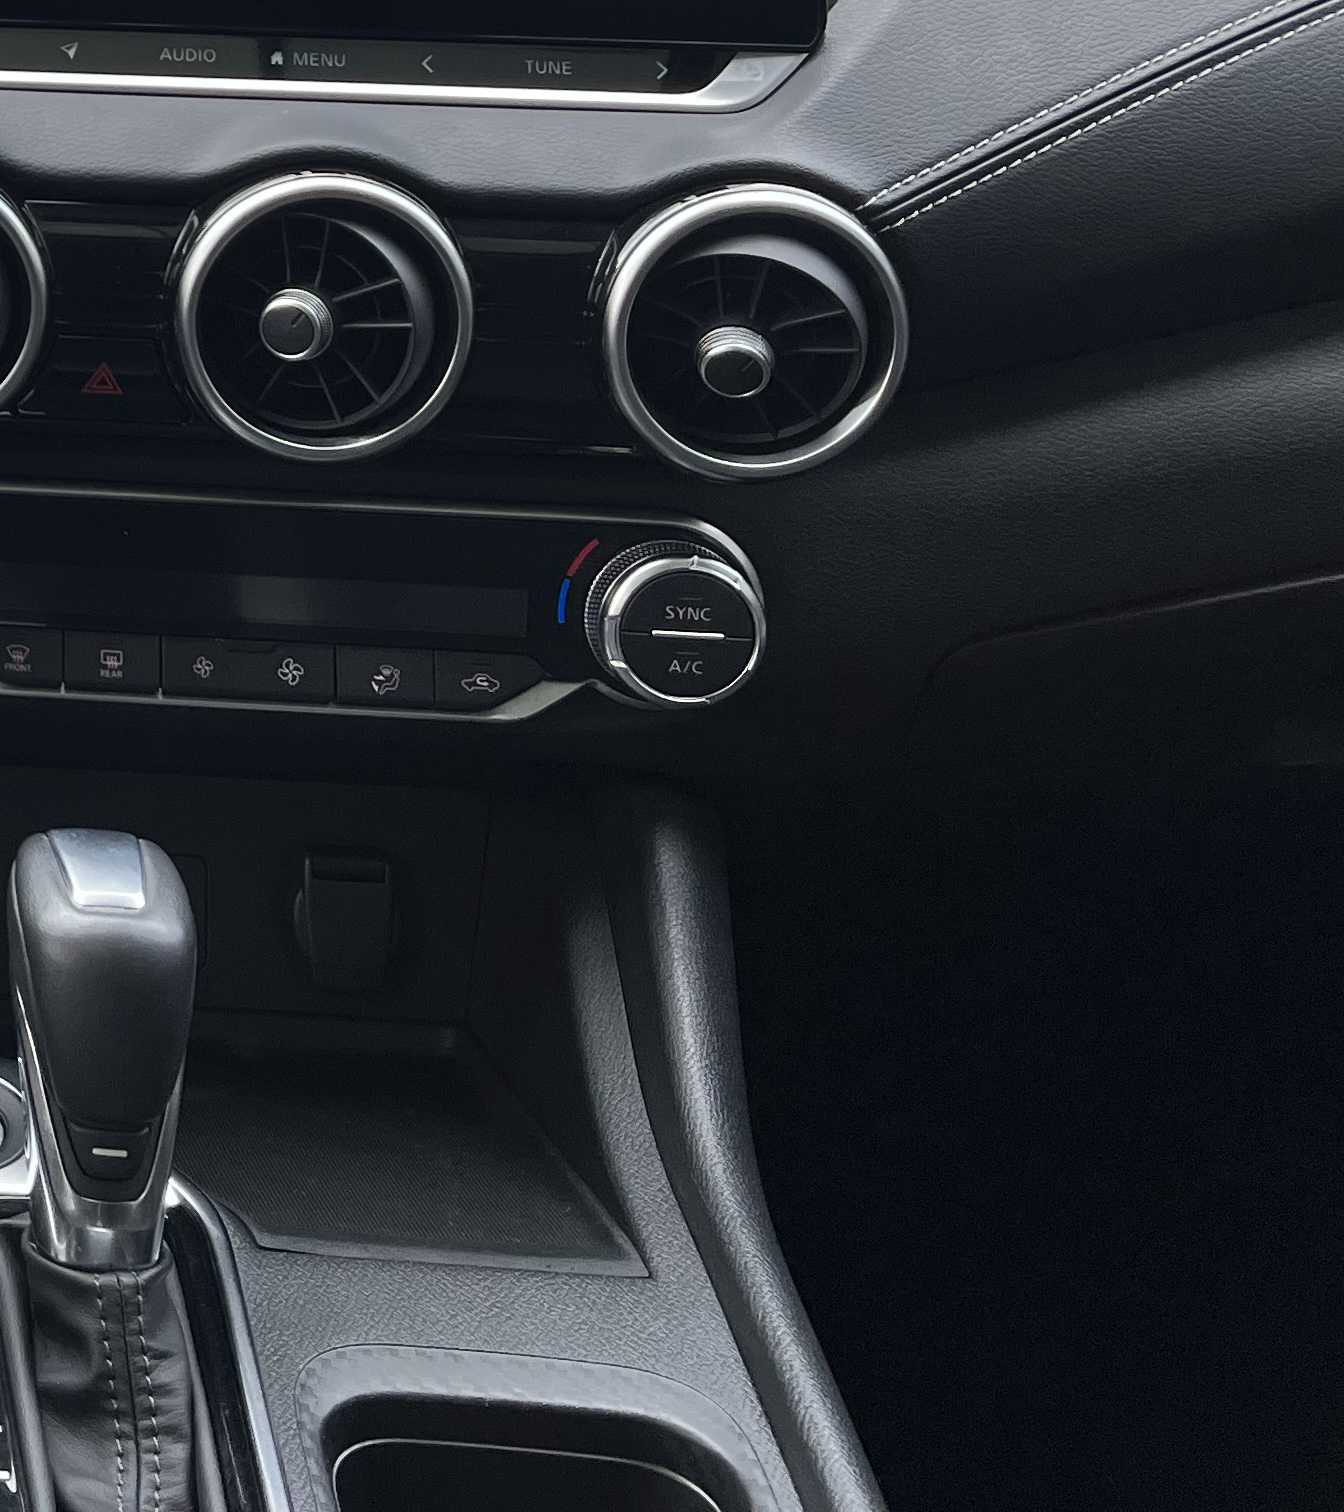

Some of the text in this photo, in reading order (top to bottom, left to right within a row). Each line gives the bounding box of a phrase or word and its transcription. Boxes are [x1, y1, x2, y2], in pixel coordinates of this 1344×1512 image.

[160, 47, 217, 63] AUDIO
[293, 52, 347, 68] MENU
[524, 59, 573, 76] TUNE
[664, 604, 713, 623] SYNC
[4, 663, 32, 673] FRONT
[100, 669, 123, 678] REAR
[669, 658, 704, 676] A/C
